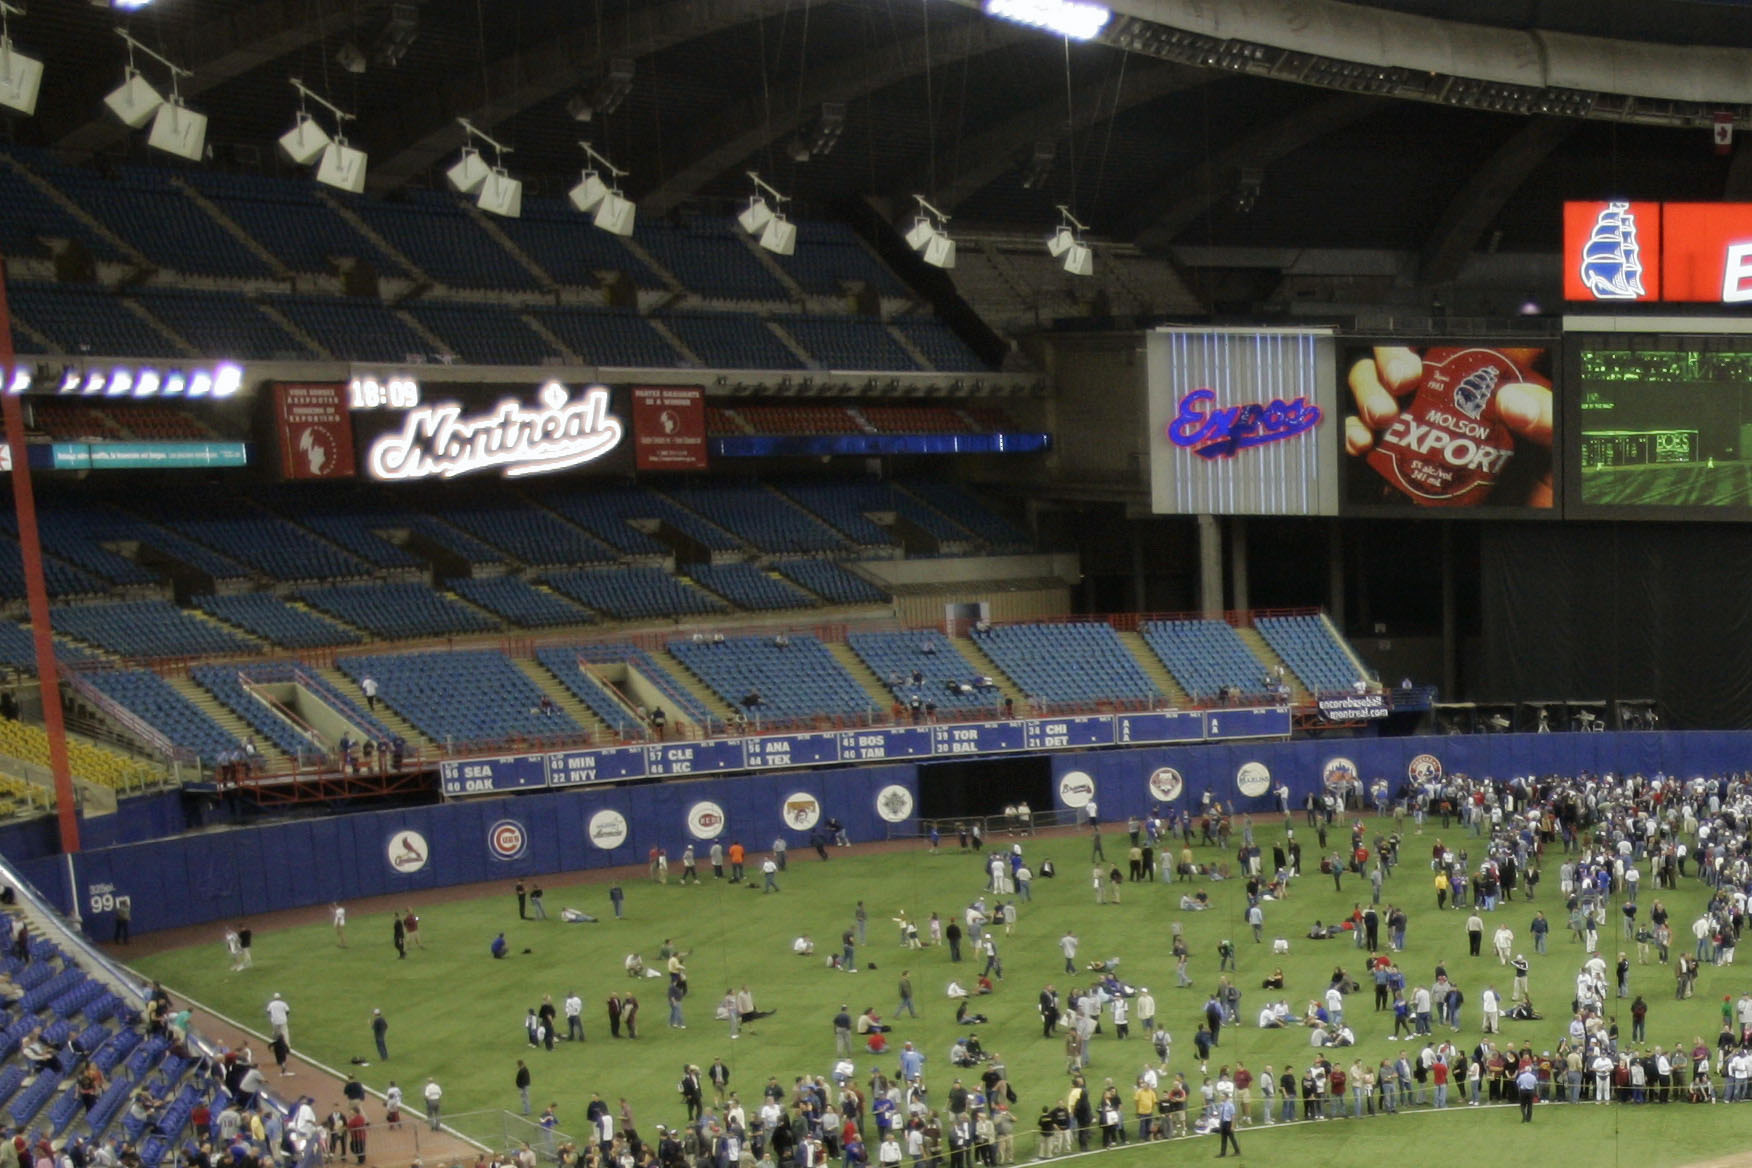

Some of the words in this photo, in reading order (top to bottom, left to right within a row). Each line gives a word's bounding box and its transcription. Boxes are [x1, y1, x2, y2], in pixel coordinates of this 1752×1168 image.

[350, 380, 418, 408] 18:09
[1168, 388, 1324, 459] Expos
[1425, 410, 1490, 440] MOLSON
[1384, 413, 1515, 473] EXPORT
[1046, 724, 1067, 734] CHI
[953, 730, 978, 740] TOR
[859, 736, 884, 746] BOS
[1045, 736, 1068, 747] DET
[766, 742, 790, 752] ANA
[953, 742, 978, 752] BAL
[668, 749, 693, 760] CLE
[860, 748, 885, 758] TAM
[568, 757, 595, 769] MIN
[766, 754, 791, 765] TEX
[464, 765, 492, 778] SEA
[672, 762, 691, 773] KC
[570, 769, 597, 781] NYY
[465, 778, 493, 791] OAK
